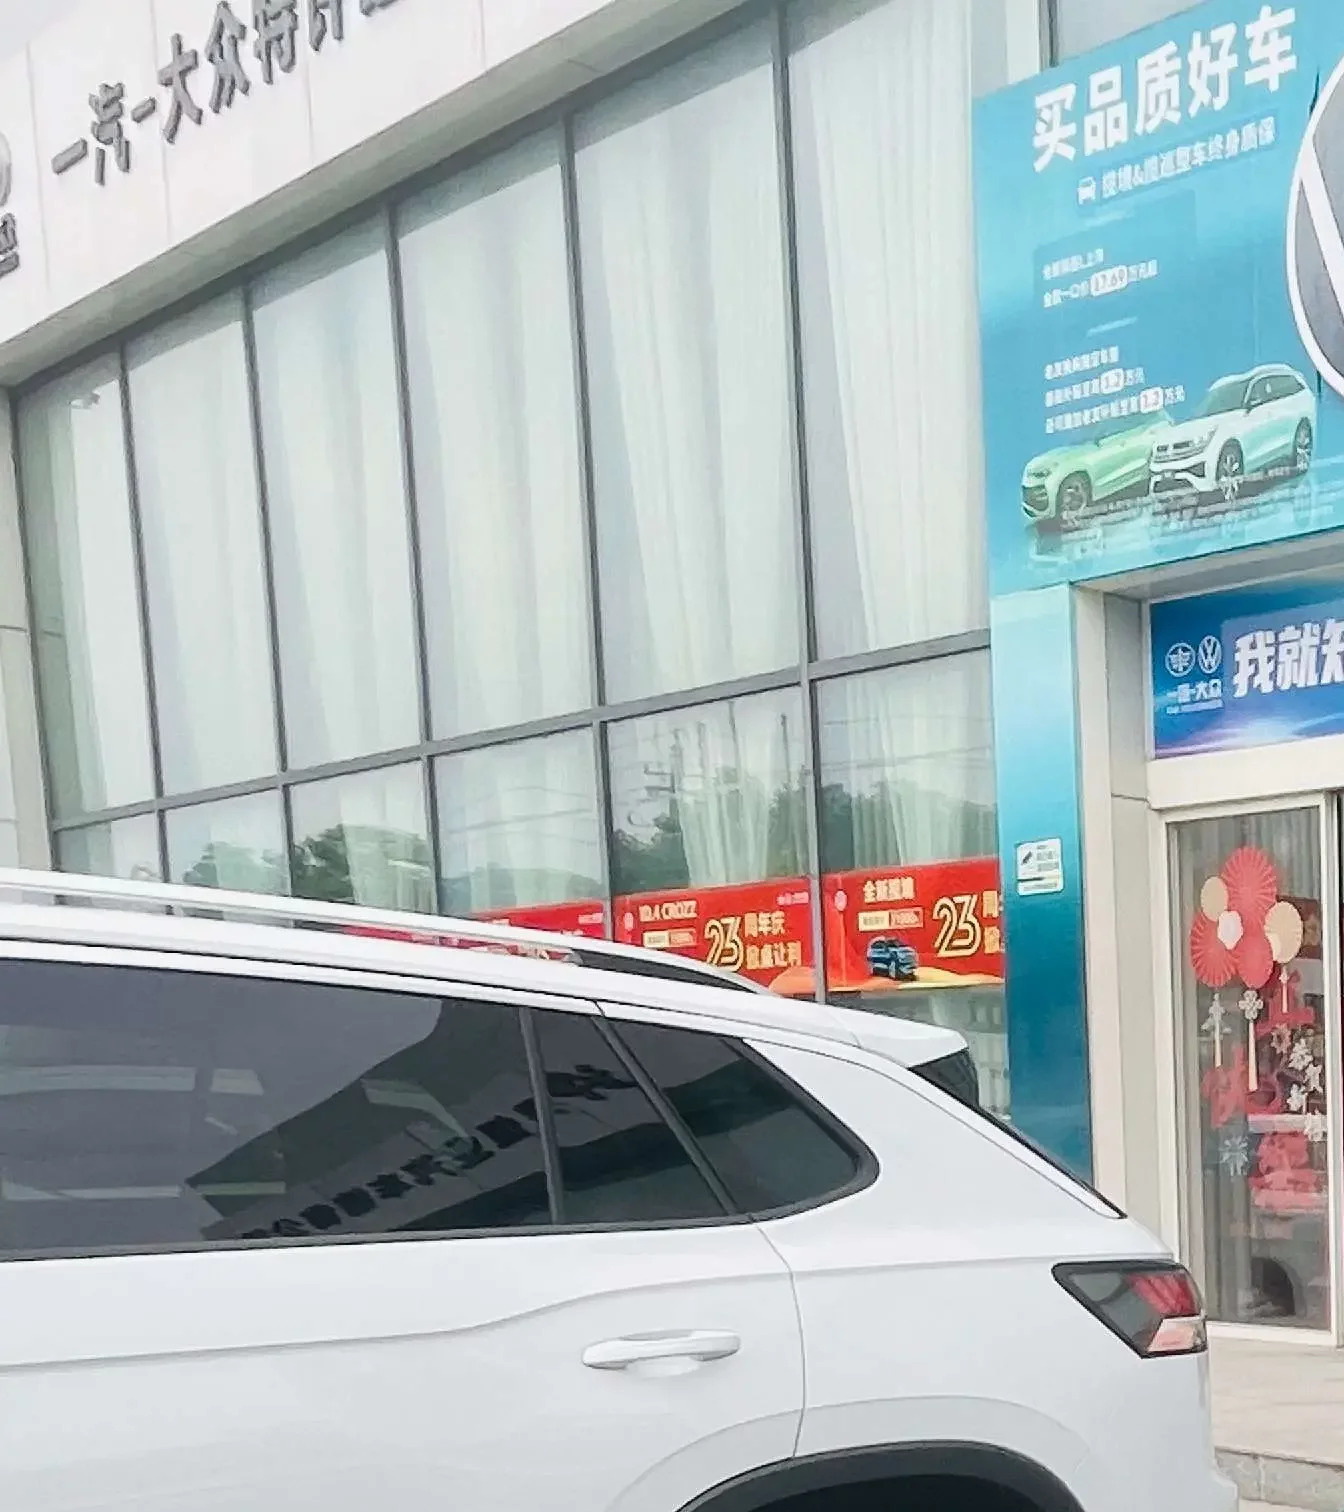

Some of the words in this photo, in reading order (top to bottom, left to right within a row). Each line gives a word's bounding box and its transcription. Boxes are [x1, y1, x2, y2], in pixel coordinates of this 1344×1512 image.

[1033, 4, 1297, 172] 买品质好车
[703, 916, 744, 973] 23
[932, 894, 982, 959] 23
